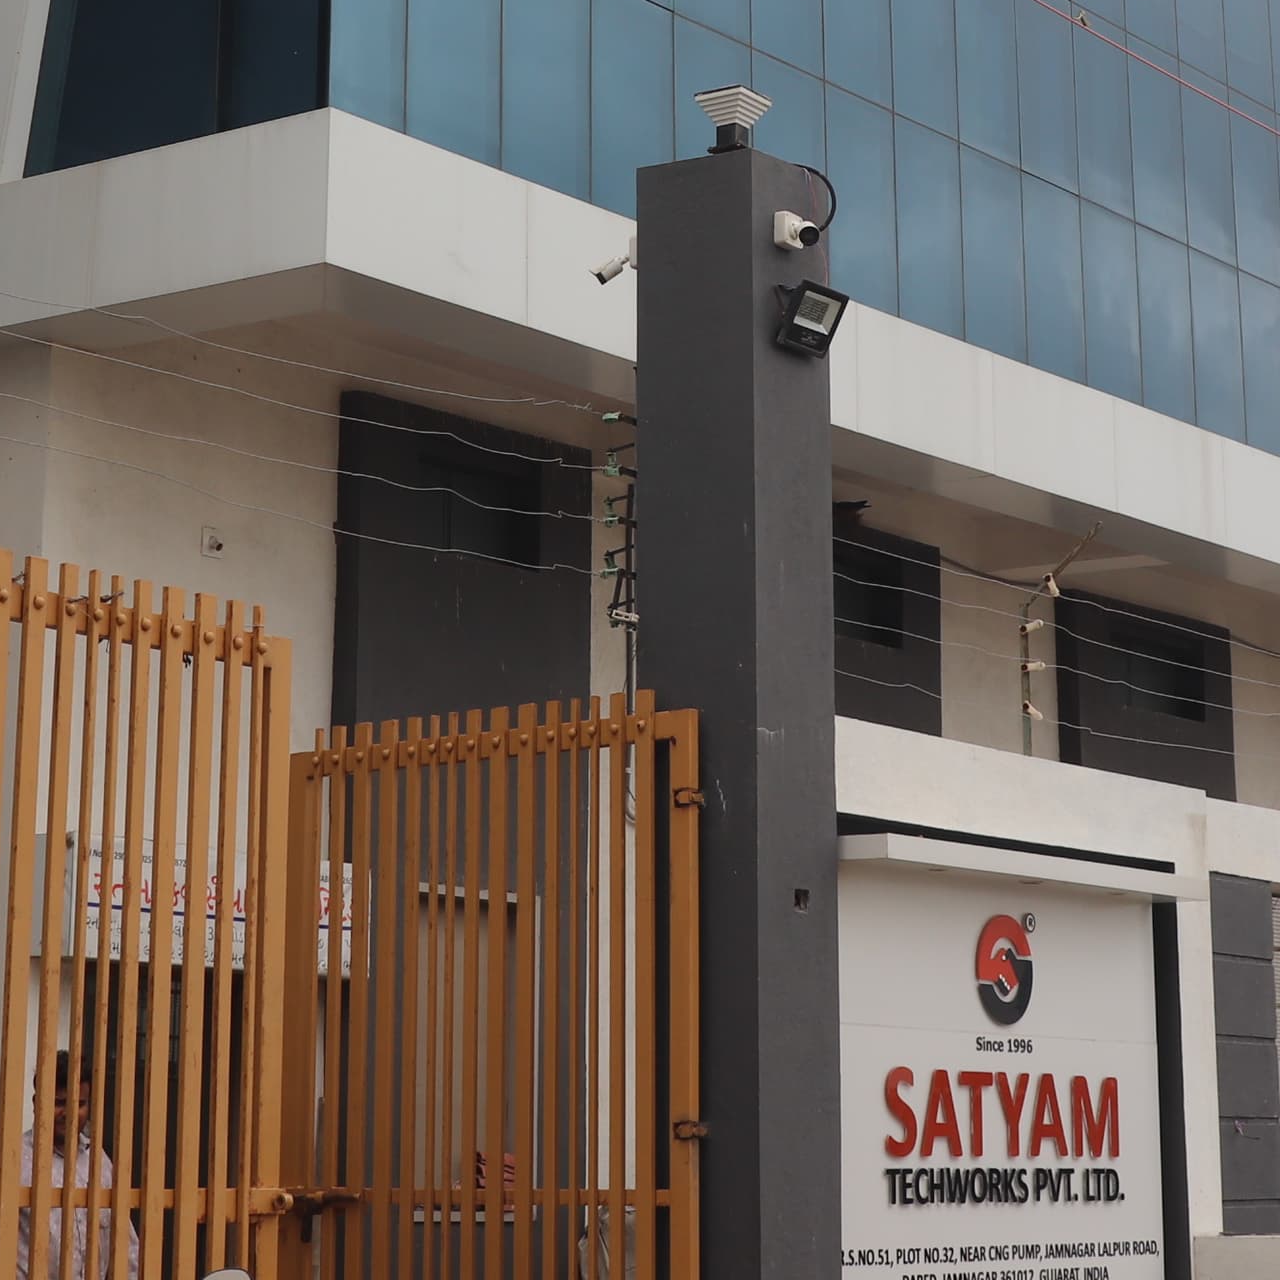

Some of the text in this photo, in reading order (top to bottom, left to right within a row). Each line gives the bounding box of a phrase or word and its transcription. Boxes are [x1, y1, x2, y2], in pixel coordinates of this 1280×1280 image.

[975, 1035, 1033, 1054] Since 1996
[884, 1065, 1120, 1158] SATYAM
[884, 1167, 1125, 1206] TECHWORKS PVT. LTD.
[896, 1247, 921, 1265] PLOT
[923, 1246, 958, 1265] NO.32,
[959, 1245, 987, 1263] NEAR
[988, 1244, 1010, 1262] CNG
[1012, 1243, 1042, 1262] PUMP,
[1044, 1242, 1096, 1259] JAMNAGAR
[1097, 1241, 1131, 1257] LALPUR
[1132, 1240, 1160, 1257] ROAD,
